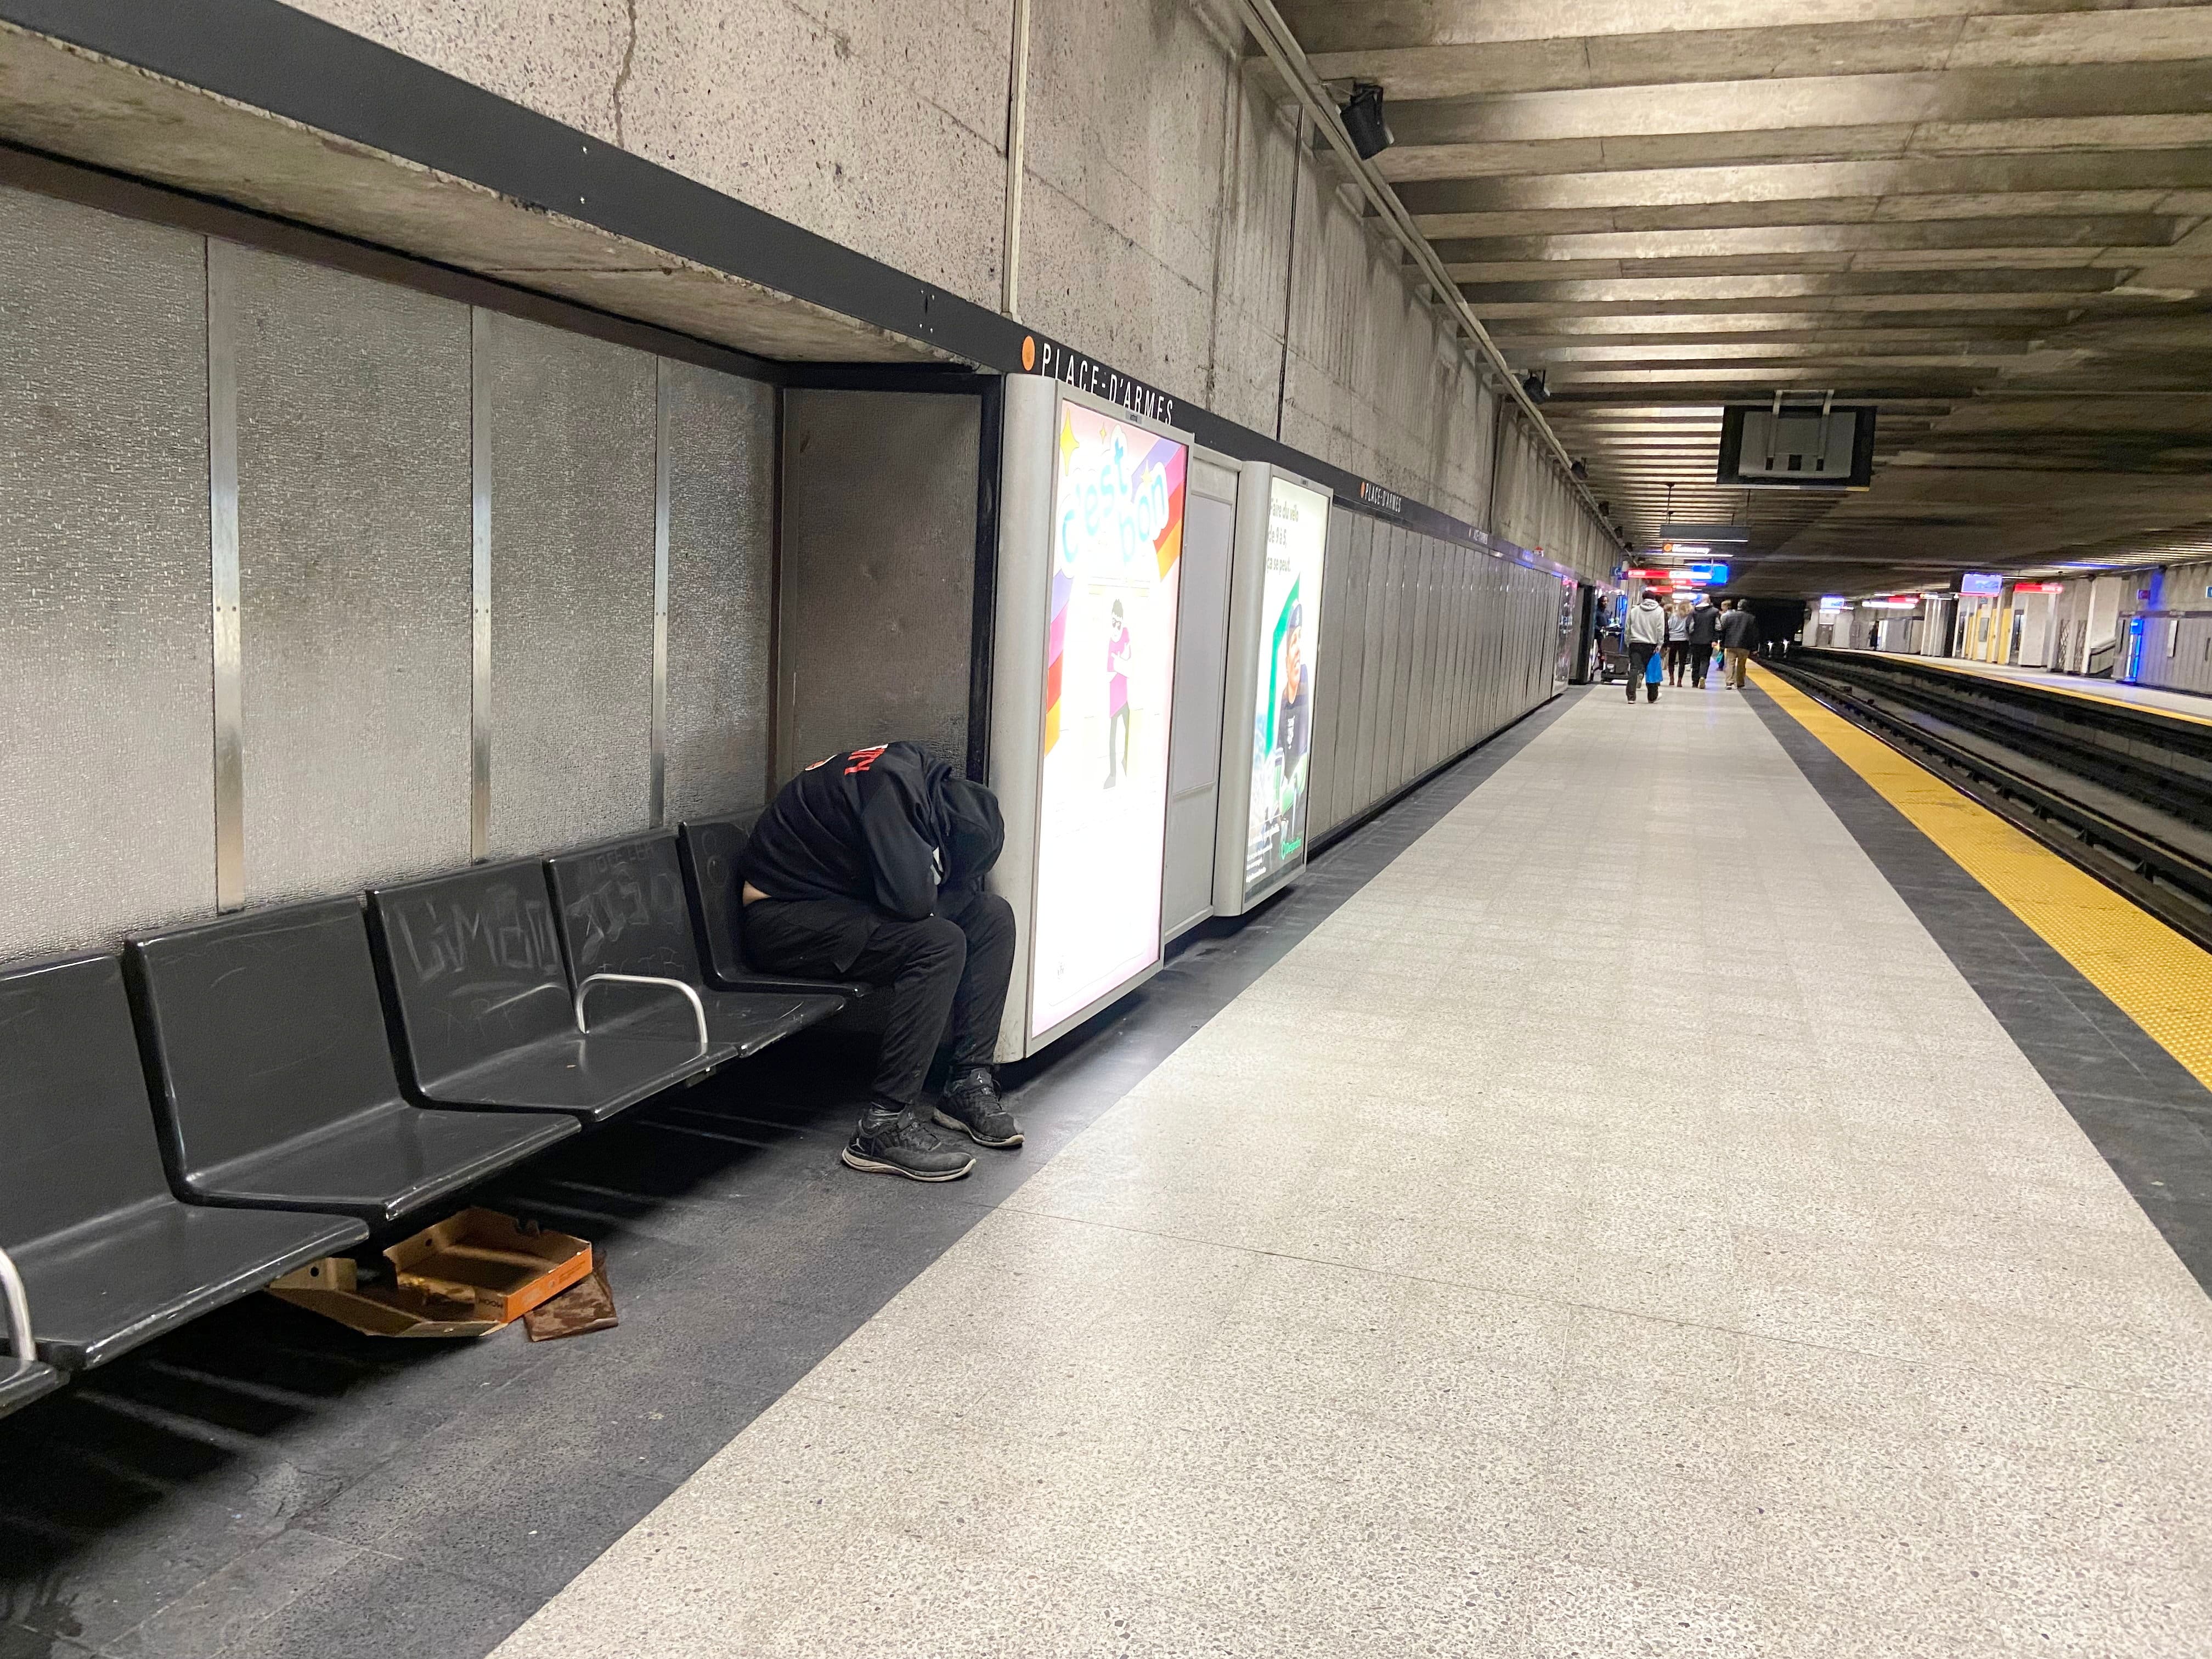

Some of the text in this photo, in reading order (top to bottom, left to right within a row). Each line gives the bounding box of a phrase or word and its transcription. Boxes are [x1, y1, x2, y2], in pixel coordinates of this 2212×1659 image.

[1042, 343, 1173, 426] PLACE-D'ARMES
[1118, 473, 1166, 563] bon
[1282, 501, 1289, 520] du
[1268, 524, 1274, 543] de
[1273, 558, 1278, 571] se
